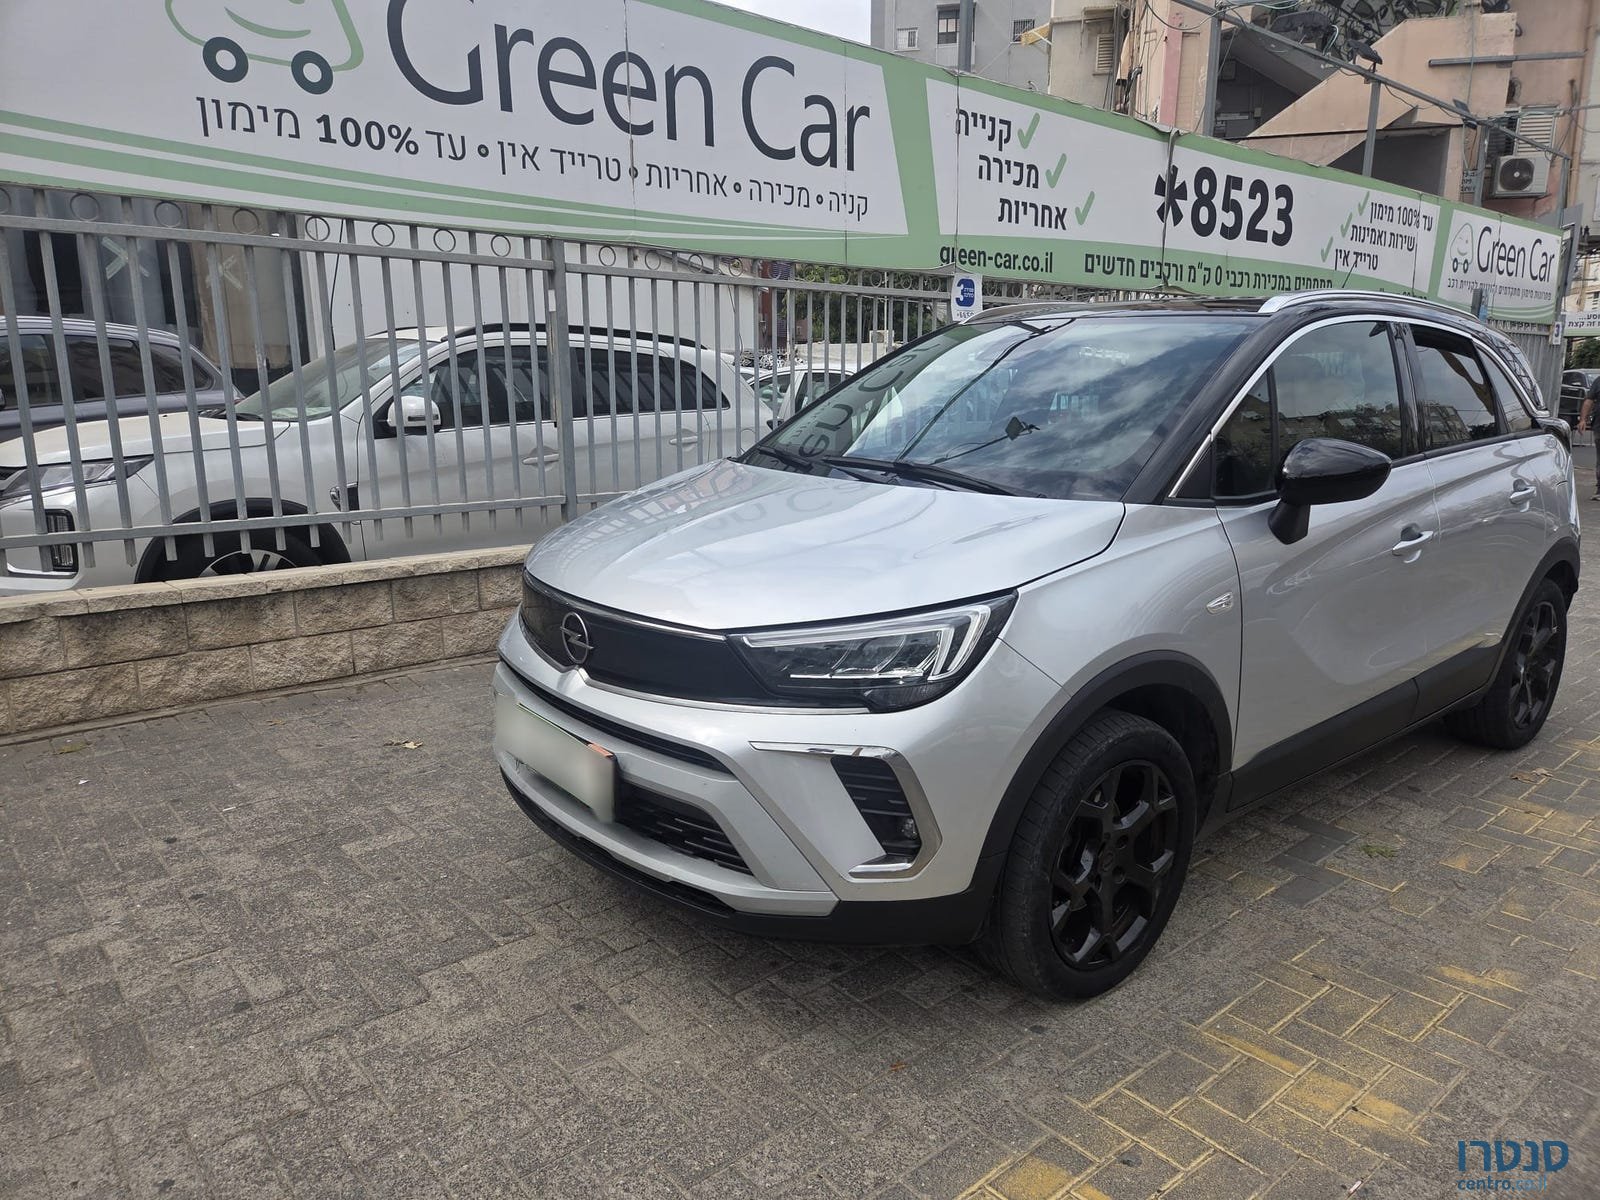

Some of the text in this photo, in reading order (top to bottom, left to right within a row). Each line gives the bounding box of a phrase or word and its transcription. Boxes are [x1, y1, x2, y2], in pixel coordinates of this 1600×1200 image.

[387, 0, 870, 171] Green Car
[955, 108, 1012, 151] קנייה
[196, 96, 868, 222] קניה מכירה אחריות טרייד אין עד 100% מימון
[978, 154, 1039, 189] מכירה
[998, 197, 1068, 231] אחריות
[1369, 201, 1433, 232] עד 100% מימון
[1350, 224, 1416, 252] שירות ואמינות
[1084, 253, 1135, 278] חדשים
[1334, 248, 1351, 271] אין
[1477, 226, 1556, 283] Green Car
[1139, 259, 1183, 282] ורכבים
[1226, 269, 1250, 288] רכבי
[1252, 272, 1292, 291] במכירת
